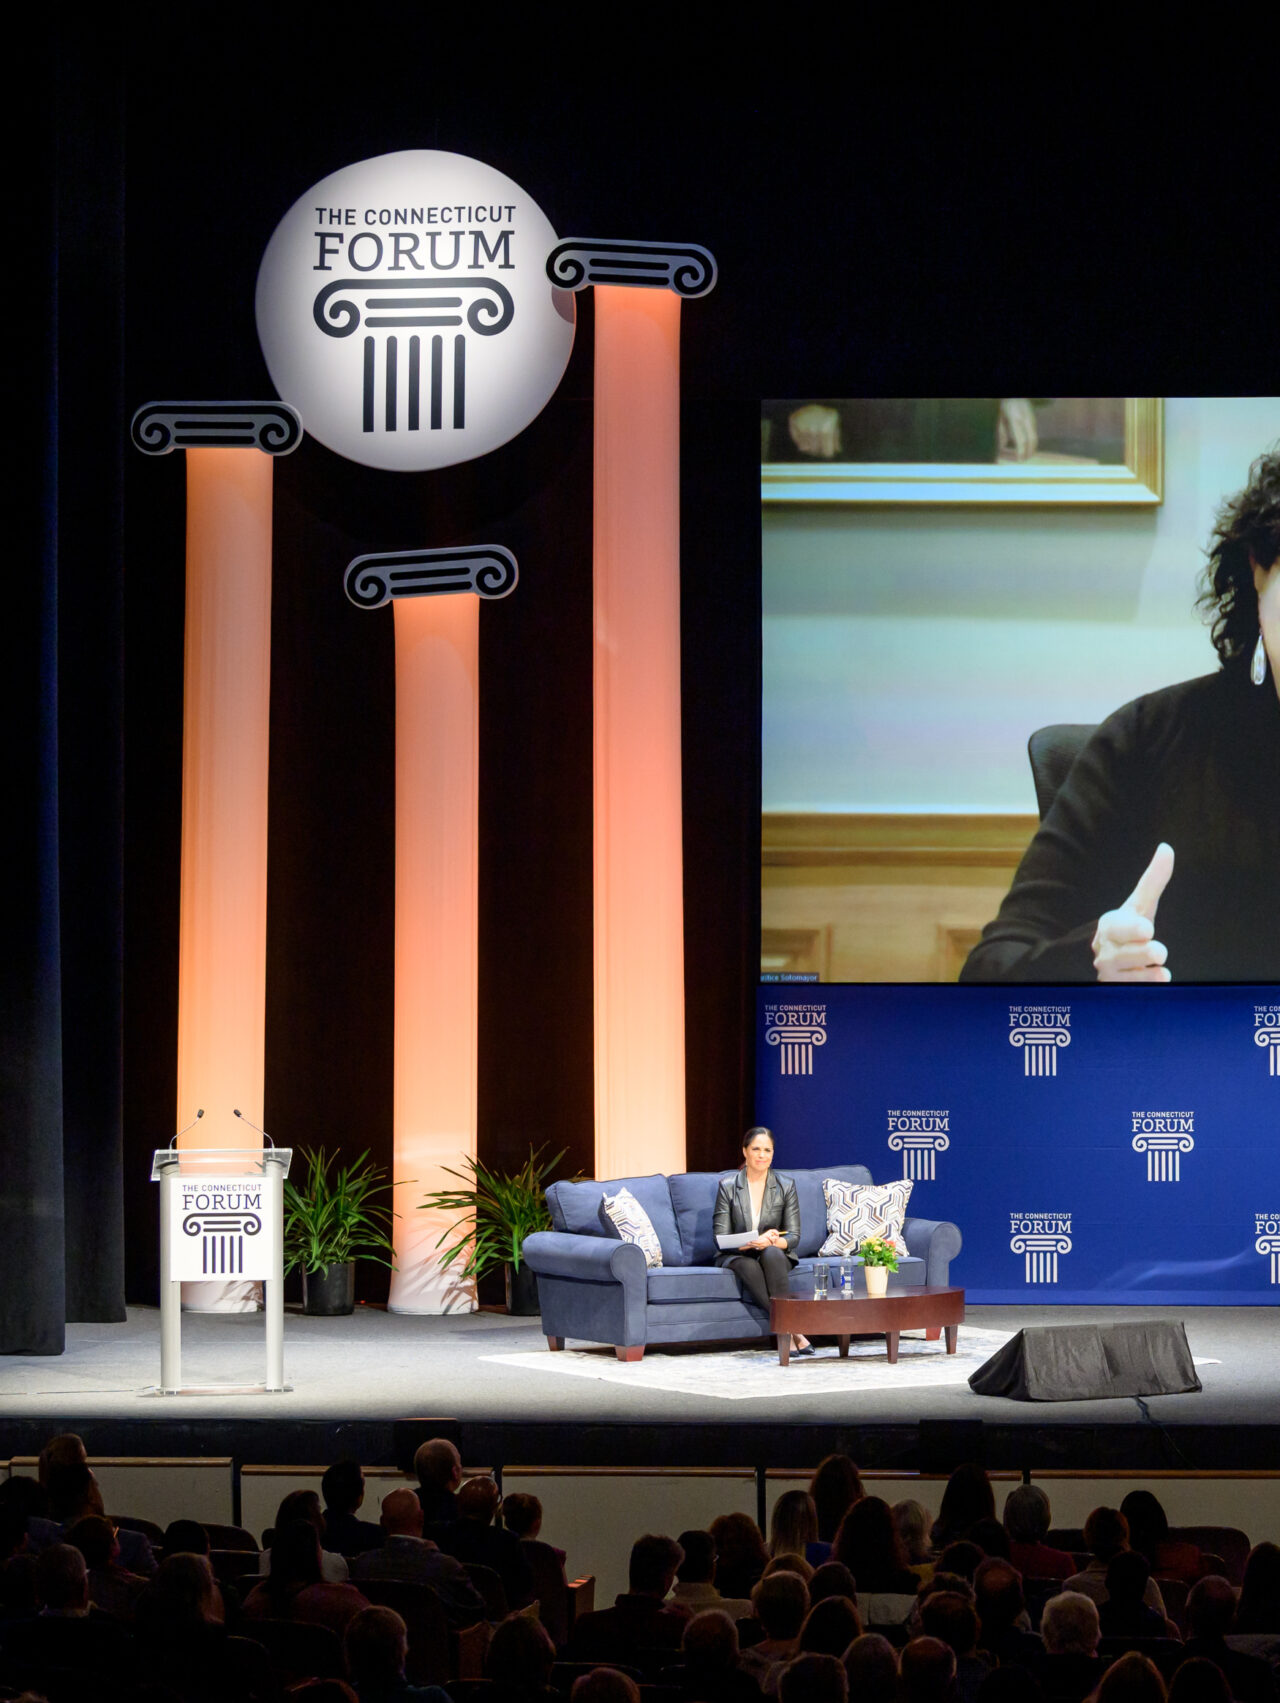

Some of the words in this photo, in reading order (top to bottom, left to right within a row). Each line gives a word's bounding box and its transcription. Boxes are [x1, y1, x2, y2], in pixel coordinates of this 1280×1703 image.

[315, 207, 357, 226] THE
[364, 205, 517, 226] CONNECTICUT
[313, 230, 516, 272] FORUM
[765, 1012, 827, 1025] FORUM
[1009, 1014, 1071, 1027] FORUM
[887, 1118, 949, 1131] FORUM
[1132, 1119, 1194, 1132] FORUM
[182, 1184, 199, 1192] THE
[201, 1183, 262, 1192] CONNECTICUT
[182, 1193, 262, 1210] FORUM
[1010, 1221, 1072, 1234] FORUM
